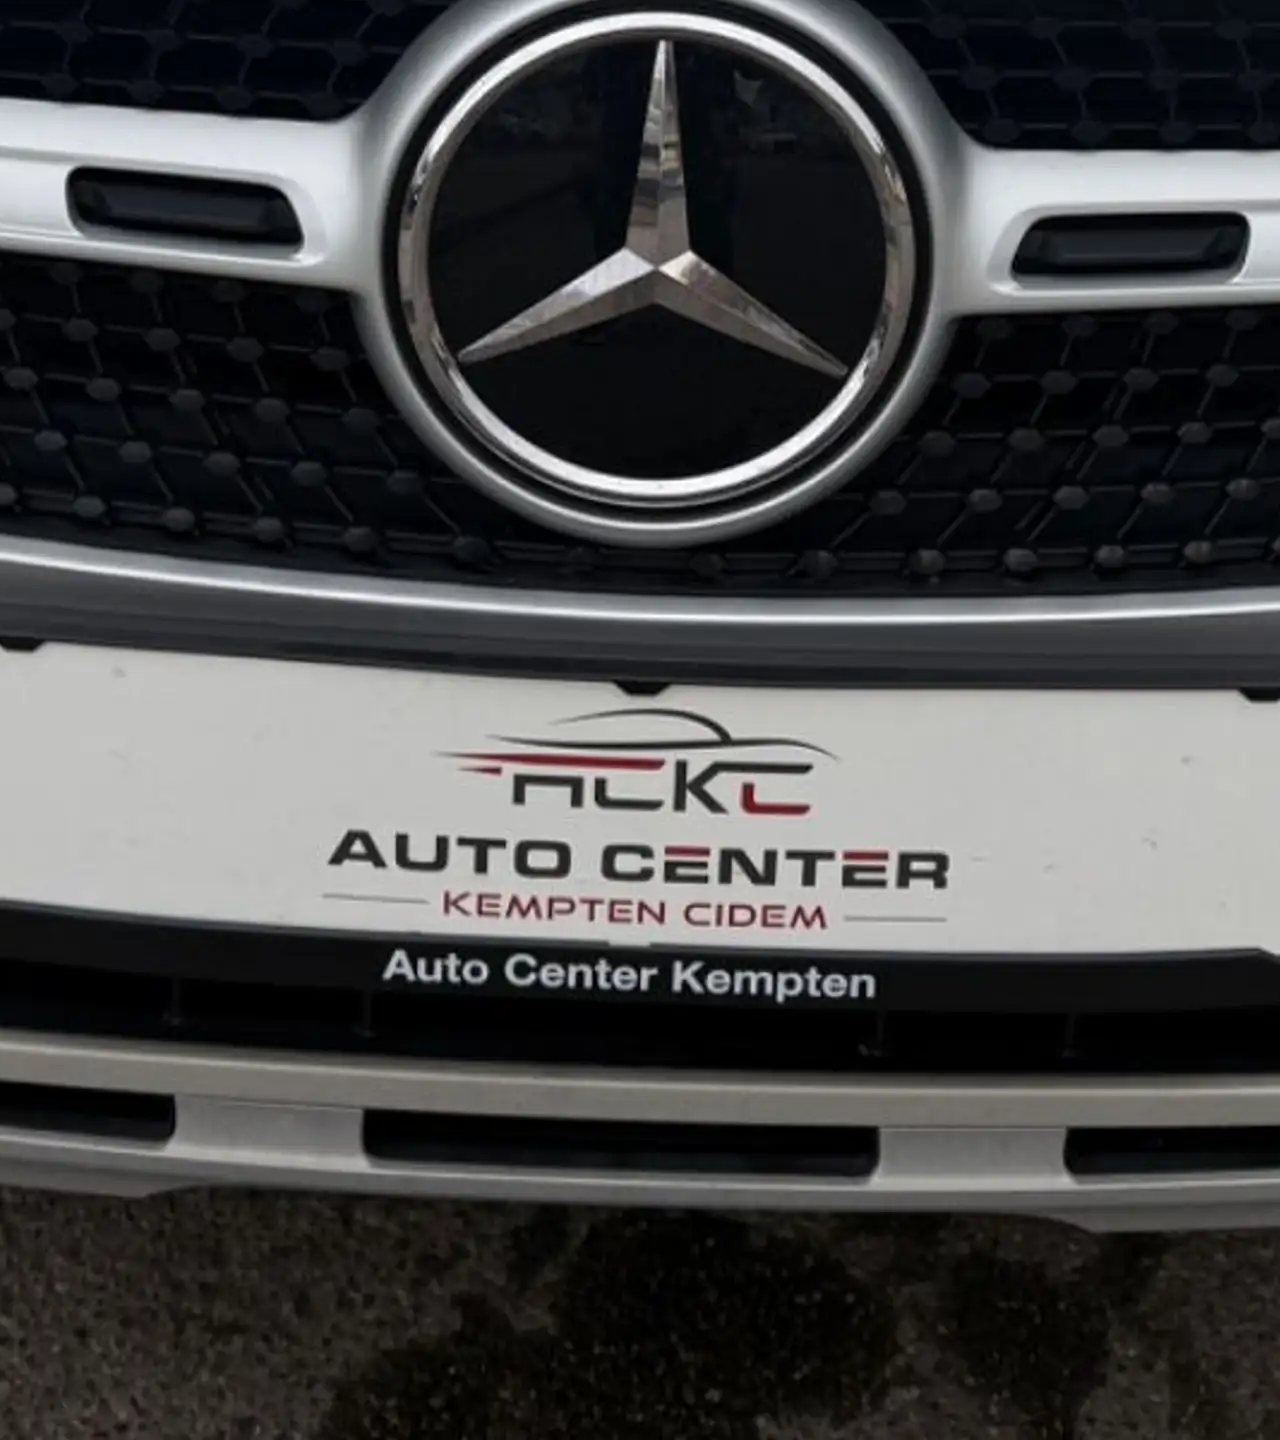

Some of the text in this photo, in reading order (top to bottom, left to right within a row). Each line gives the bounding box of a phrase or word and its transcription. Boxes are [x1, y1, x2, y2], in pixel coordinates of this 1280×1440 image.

[327, 828, 951, 891] AUTO CENTER
[442, 890, 828, 930] KEMPTEN CIDEM
[381, 948, 877, 1003] Auto Center Kempten
